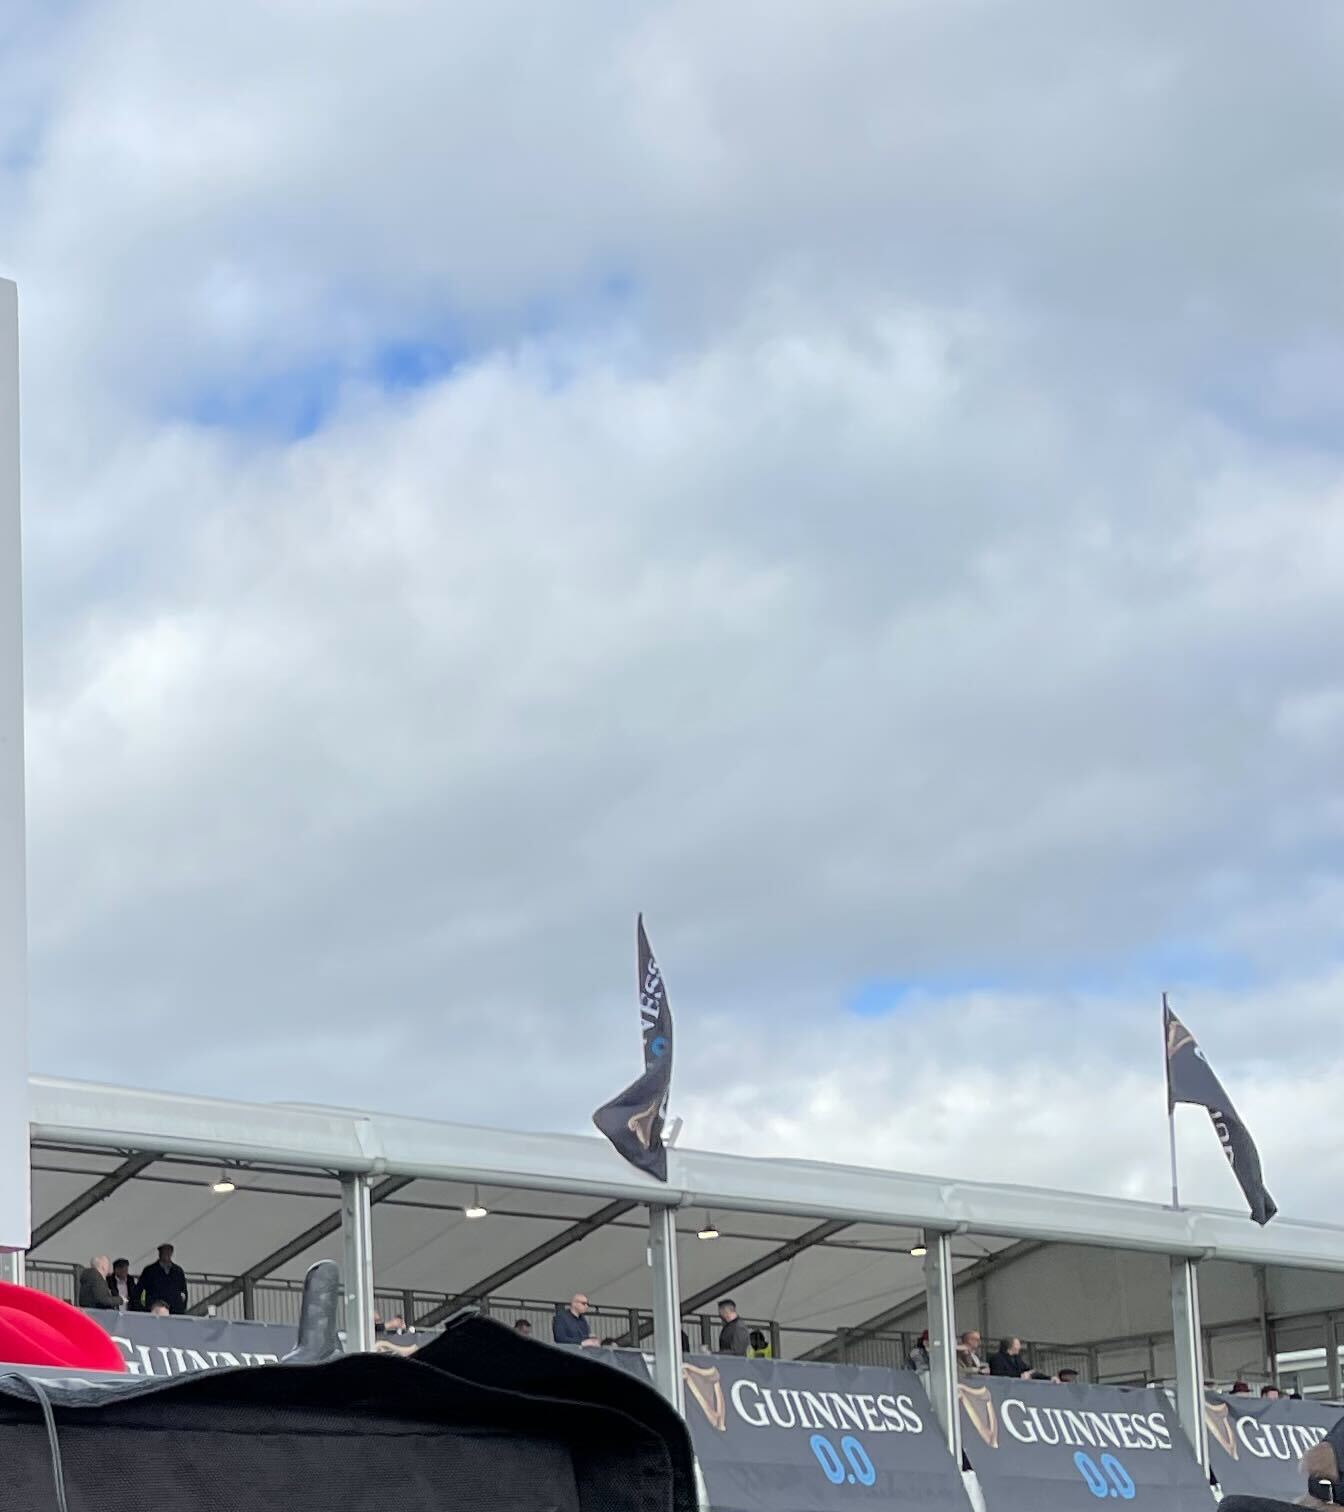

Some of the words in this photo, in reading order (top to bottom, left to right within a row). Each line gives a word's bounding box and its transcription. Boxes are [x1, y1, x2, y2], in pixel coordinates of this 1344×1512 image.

[730, 1378, 924, 1434] GUINNESS
[1000, 1398, 1173, 1451] GUINNESS
[809, 1433, 877, 1487] 0.0
[1235, 1415, 1329, 1460] GUIN
[1072, 1450, 1136, 1499] 0.0
